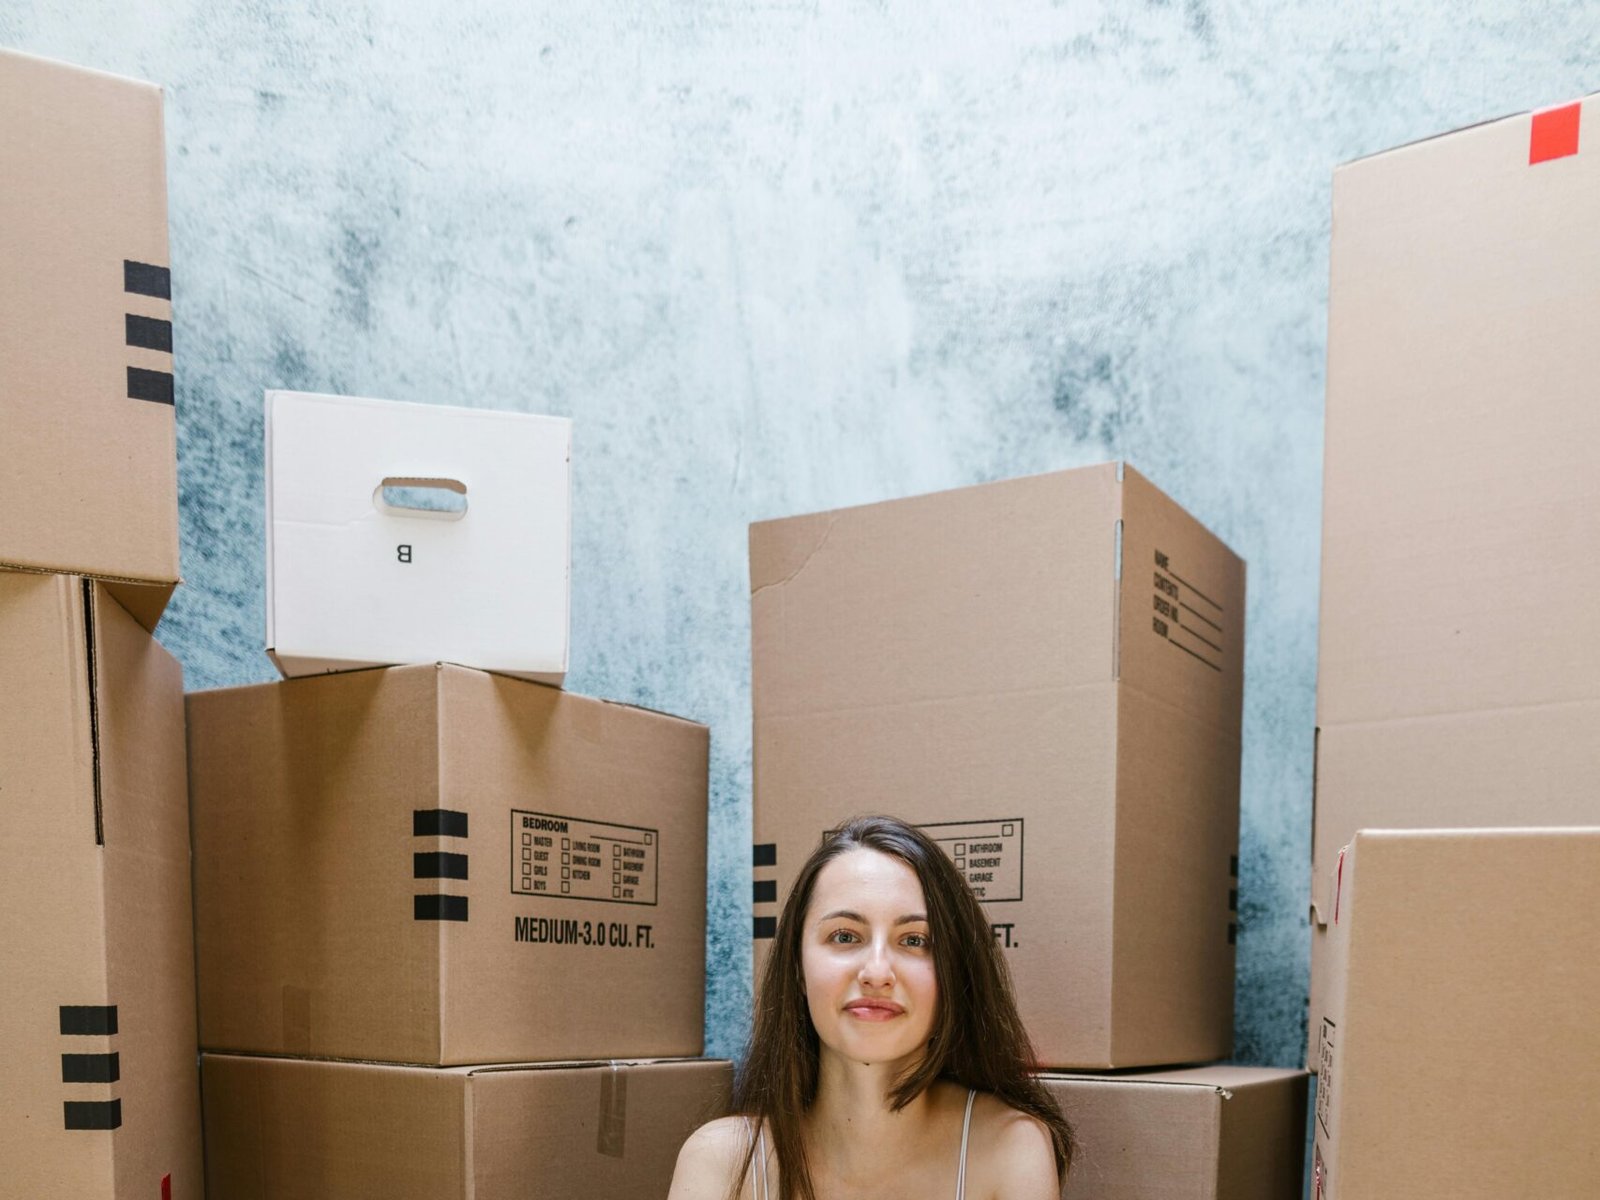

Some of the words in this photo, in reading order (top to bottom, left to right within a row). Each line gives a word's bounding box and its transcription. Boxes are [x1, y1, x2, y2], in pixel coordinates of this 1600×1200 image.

[397, 545, 411, 563] B
[523, 817, 568, 833] BEDROOM
[534, 836, 552, 847] MASTER
[572, 841, 587, 851] LIVING
[587, 843, 600, 853] ROOM
[969, 843, 1002, 854] BATHROOM
[534, 851, 549, 861] GUEST
[623, 848, 645, 858] BATHROOM
[572, 855, 587, 866] DINING
[588, 857, 601, 867] ROOM
[969, 858, 1000, 868] BASEMENT
[534, 866, 547, 876] GIRLS
[623, 861, 644, 872] BASEMENT
[572, 870, 590, 880] KITCHEN
[623, 875, 639, 885] GARAGE
[969, 873, 993, 882] GARAGE
[534, 880, 546, 890] BOYS
[623, 889, 634, 898] ATTIC
[515, 917, 606, 946] MEDIUM-3.0
[609, 923, 632, 947] CU.
[637, 925, 655, 948] FT.
